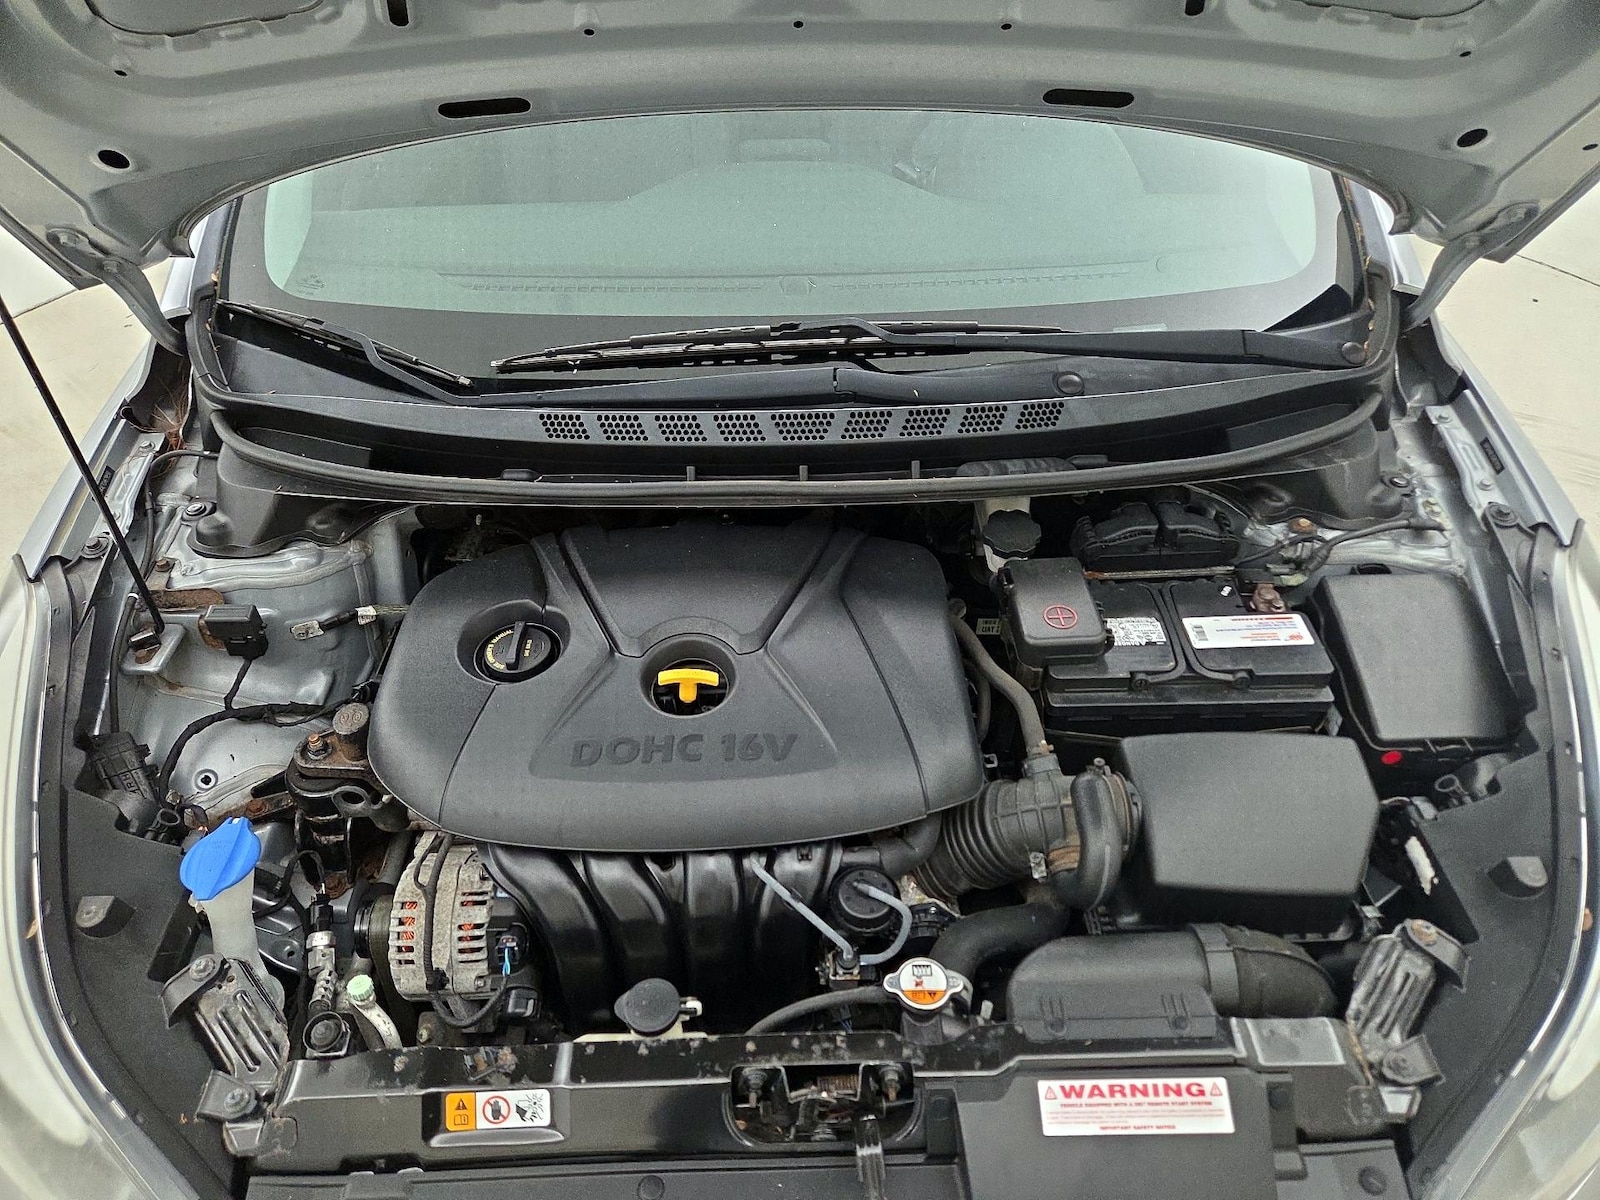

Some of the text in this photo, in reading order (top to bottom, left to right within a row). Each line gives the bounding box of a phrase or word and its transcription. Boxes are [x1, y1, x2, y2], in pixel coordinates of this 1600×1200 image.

[570, 733, 798, 767] DOHC 16V
[1060, 1083, 1206, 1099] WARNING
